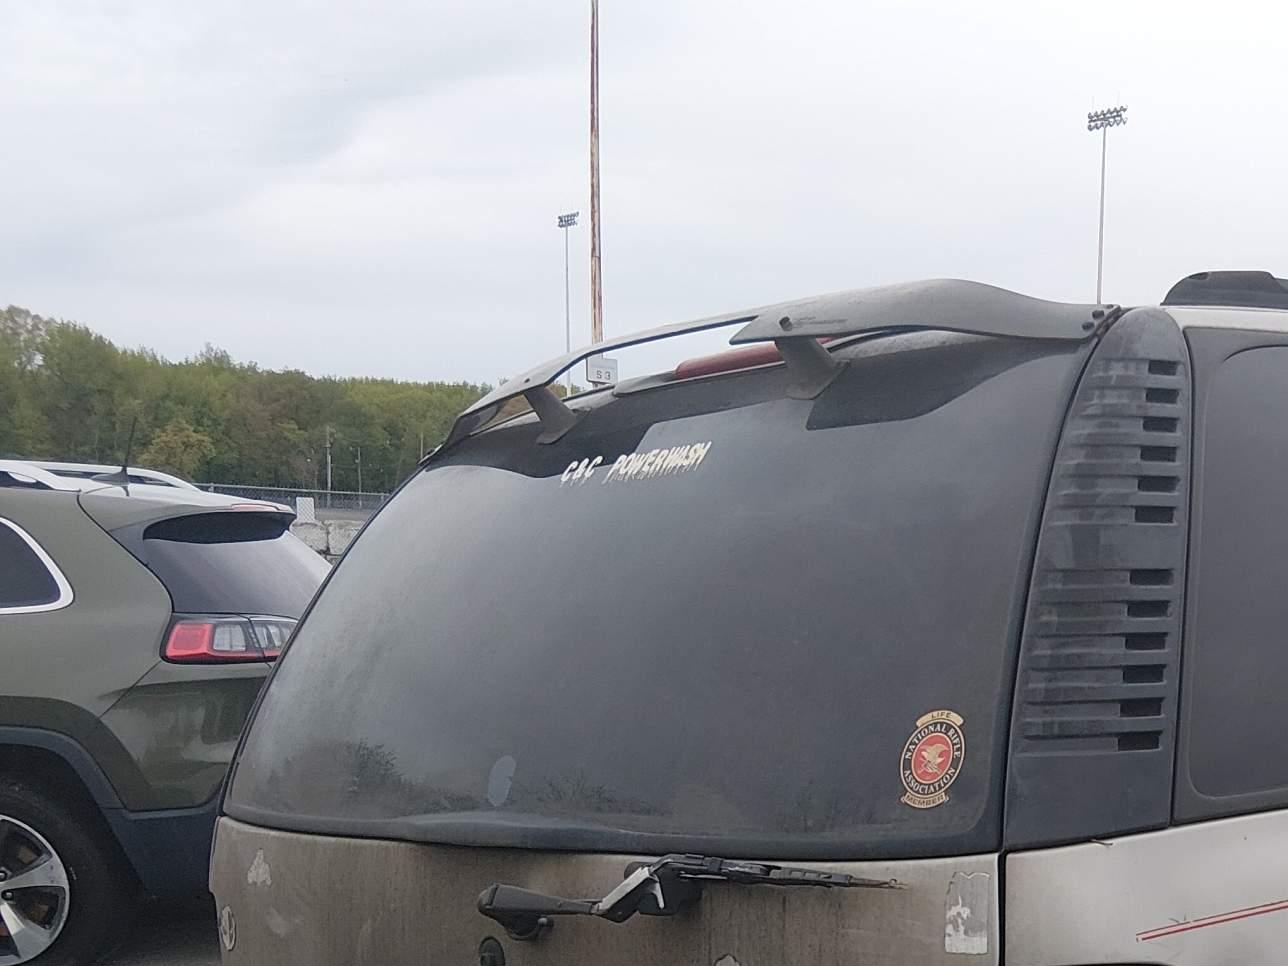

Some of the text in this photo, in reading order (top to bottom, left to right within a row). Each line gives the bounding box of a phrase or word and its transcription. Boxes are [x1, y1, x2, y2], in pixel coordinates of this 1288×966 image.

[602, 441, 712, 484] POWERWASH
[931, 711, 952, 719] LIFE
[905, 723, 961, 760] NATIONAL RIFLE
[903, 767, 956, 795] ASSOCIATION
